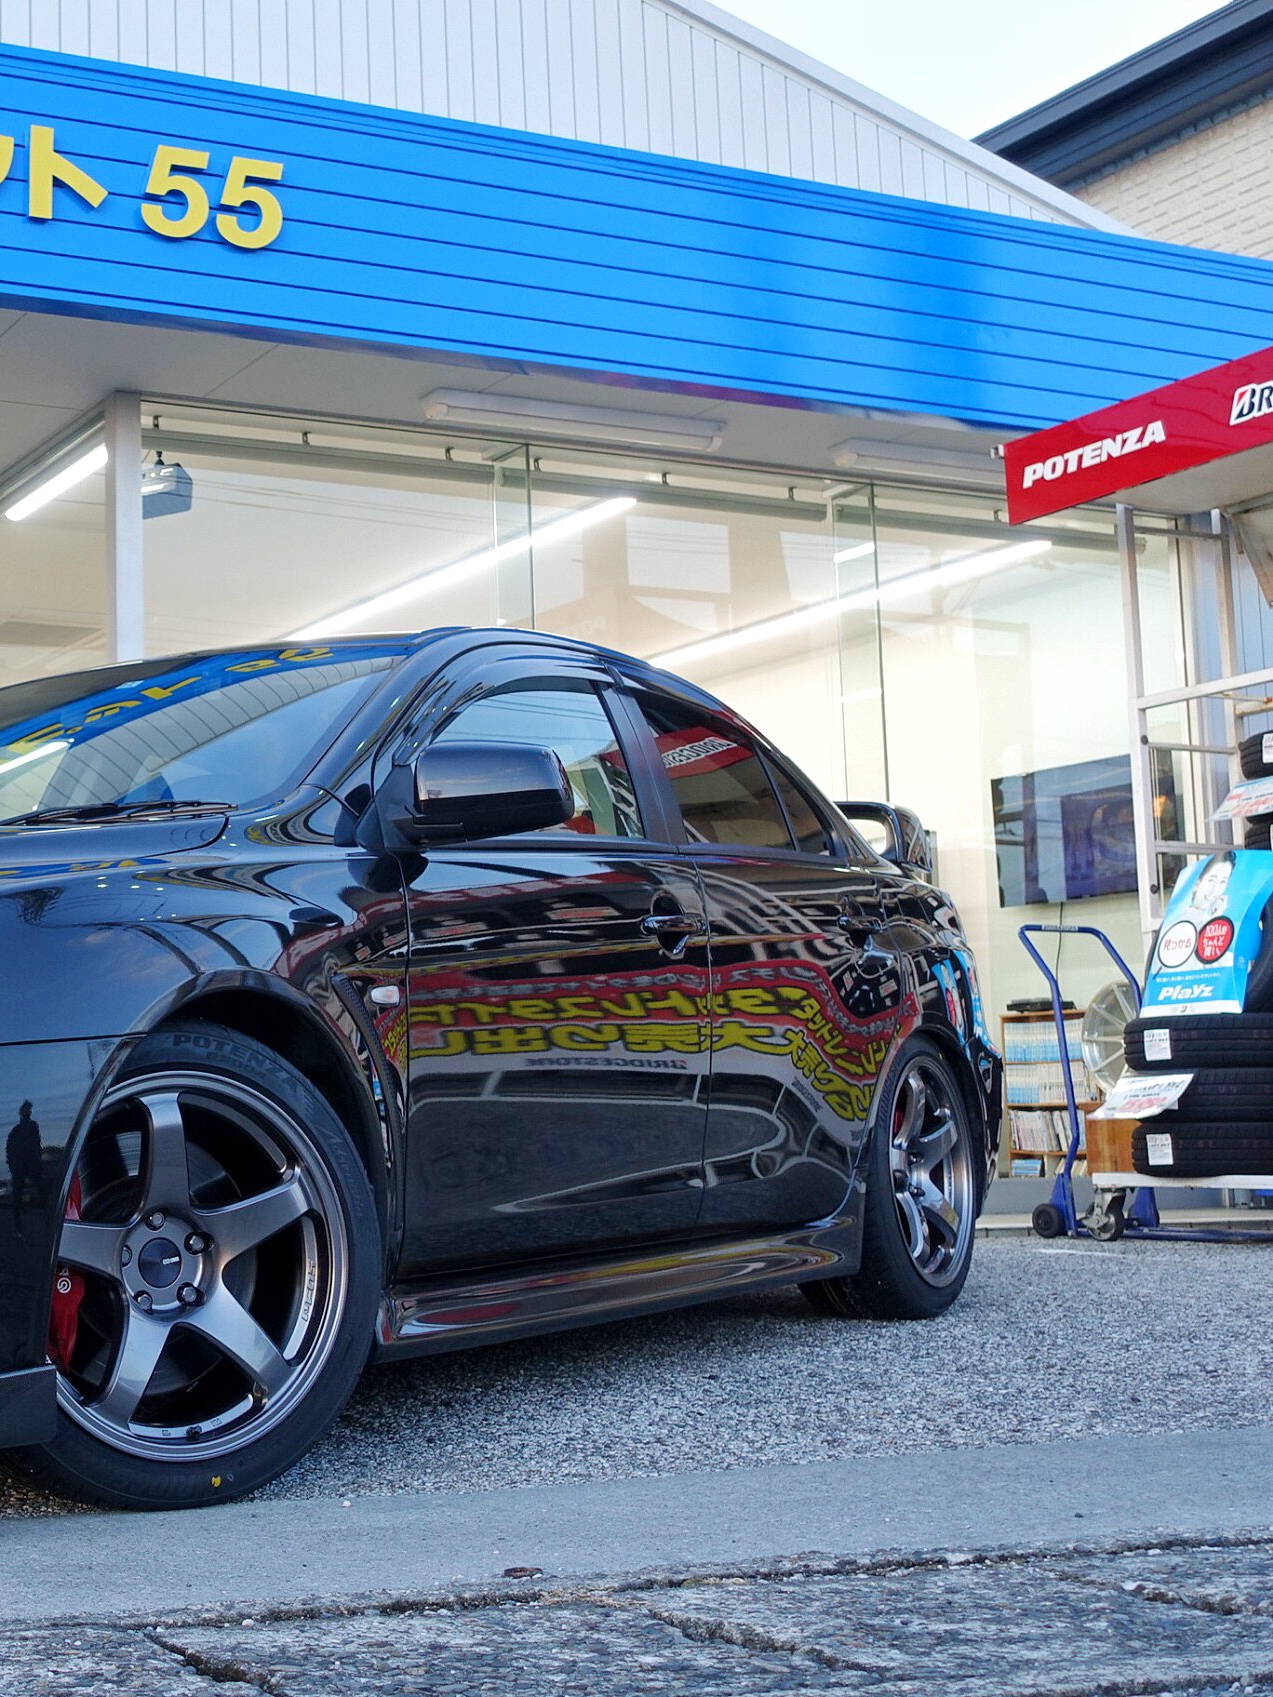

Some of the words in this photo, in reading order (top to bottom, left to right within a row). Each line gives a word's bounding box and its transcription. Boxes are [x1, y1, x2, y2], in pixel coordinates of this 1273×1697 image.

[140, 144, 283, 250] 55
[1022, 419, 1167, 489] POTENZA
[1158, 983, 1214, 1001] Playz
[173, 1033, 298, 1094] POTENZA
